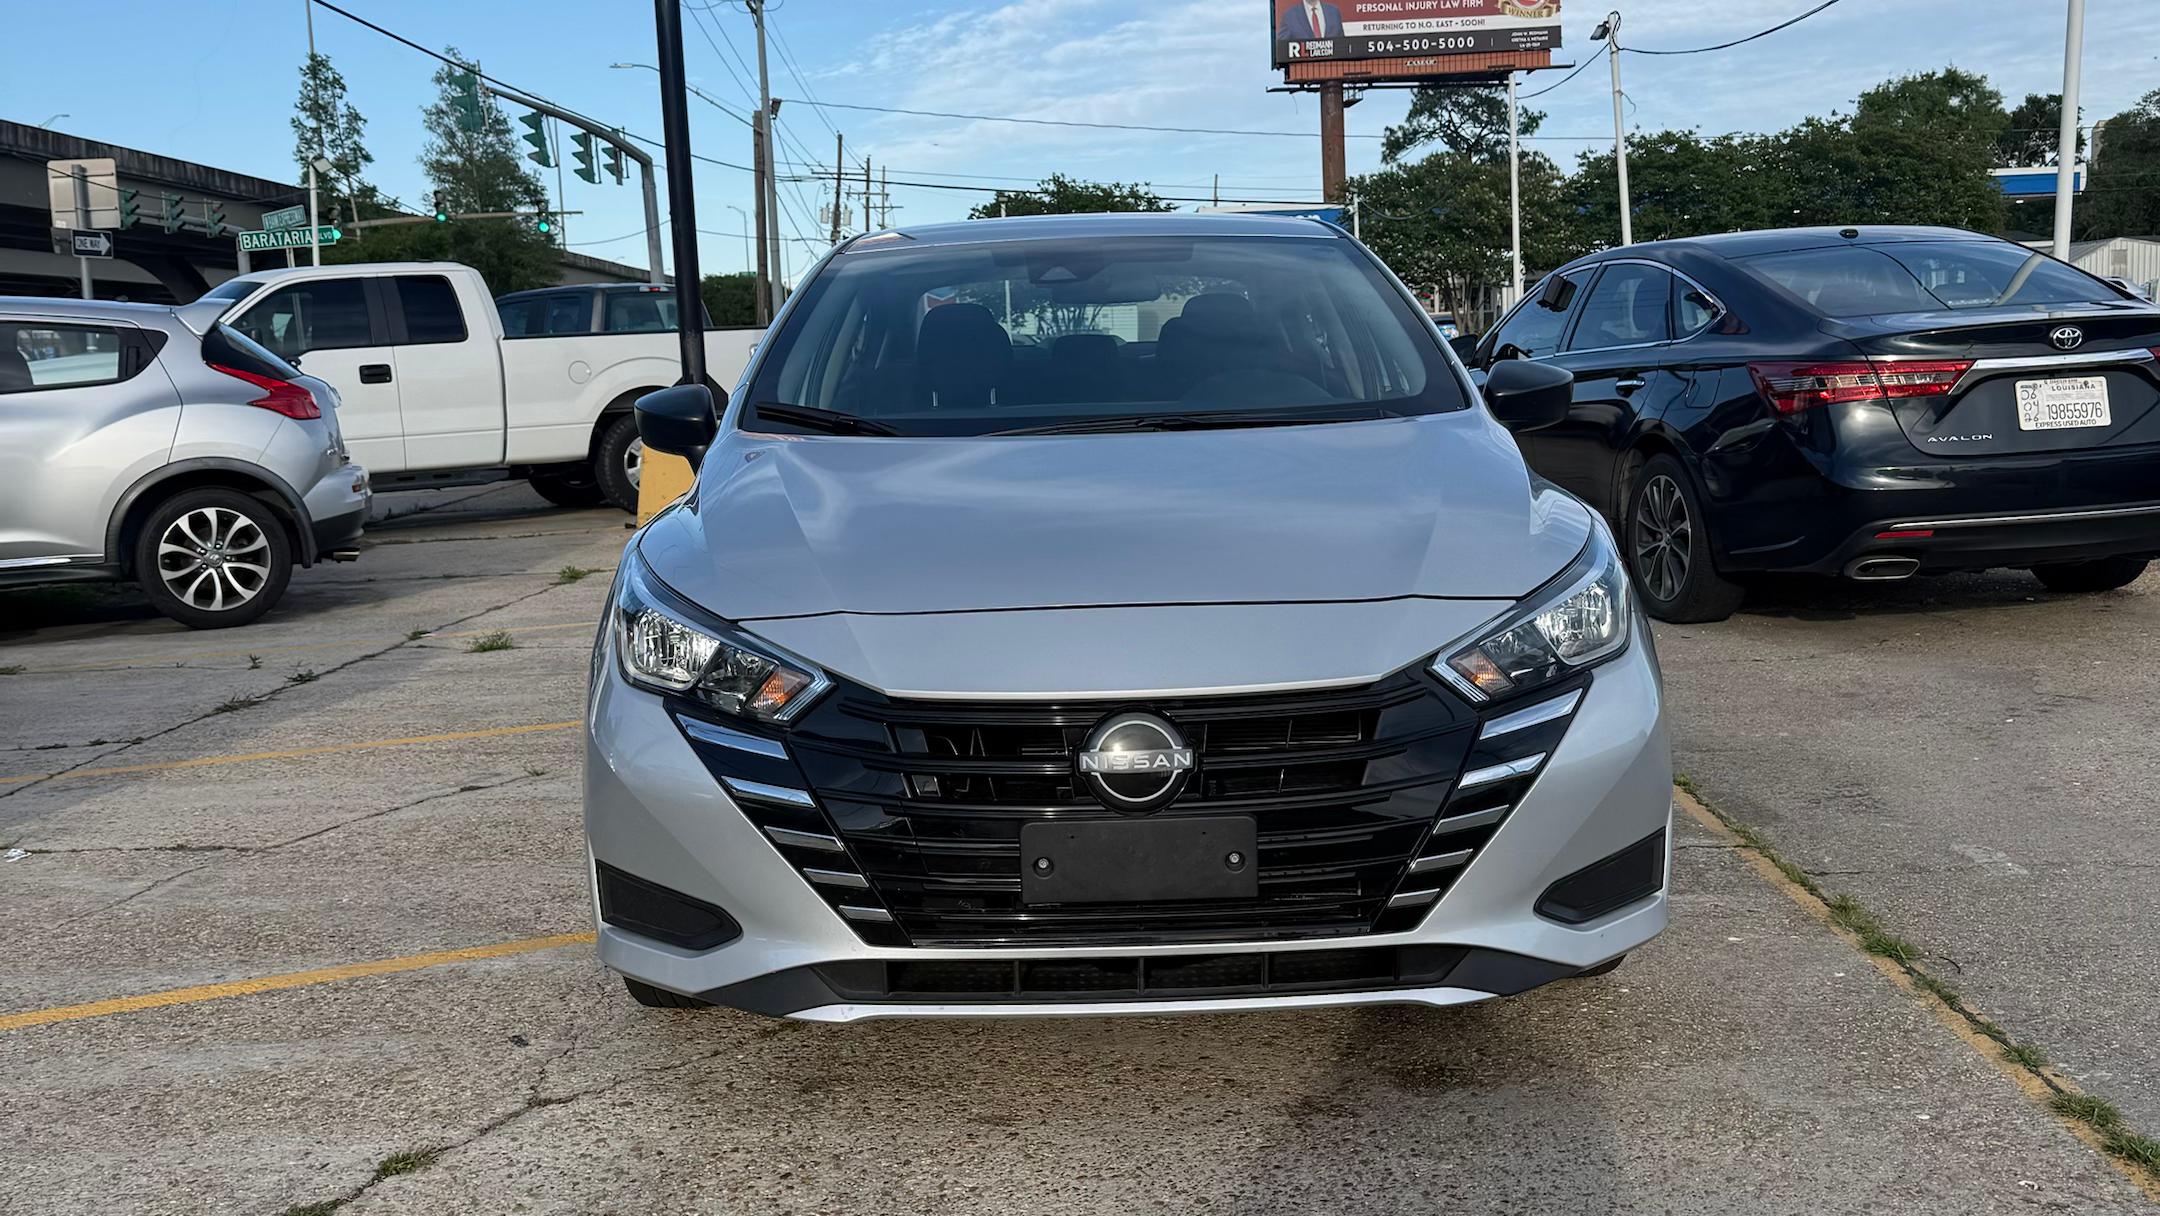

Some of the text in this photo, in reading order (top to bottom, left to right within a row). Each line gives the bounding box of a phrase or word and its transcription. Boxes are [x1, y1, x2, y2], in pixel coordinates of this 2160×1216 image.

[1356, 0, 1484, 13] PERSONAL INJURY LAW FIRM
[1508, 6, 1544, 18] WINNER
[1363, 22, 1403, 31] RETURNING
[1405, 21, 1417, 30] TO
[1436, 20, 1453, 28] EAST
[1367, 36, 1475, 53] 504-500-5000
[242, 230, 333, 249] BARATARIA LVD
[2051, 383, 2096, 392] LOUISIANA
[2046, 401, 2103, 420] 19855976
[2035, 421, 2062, 429] EXPRESS
[1927, 433, 1993, 443] AVALON
[1082, 752, 1191, 770] NISSAN
